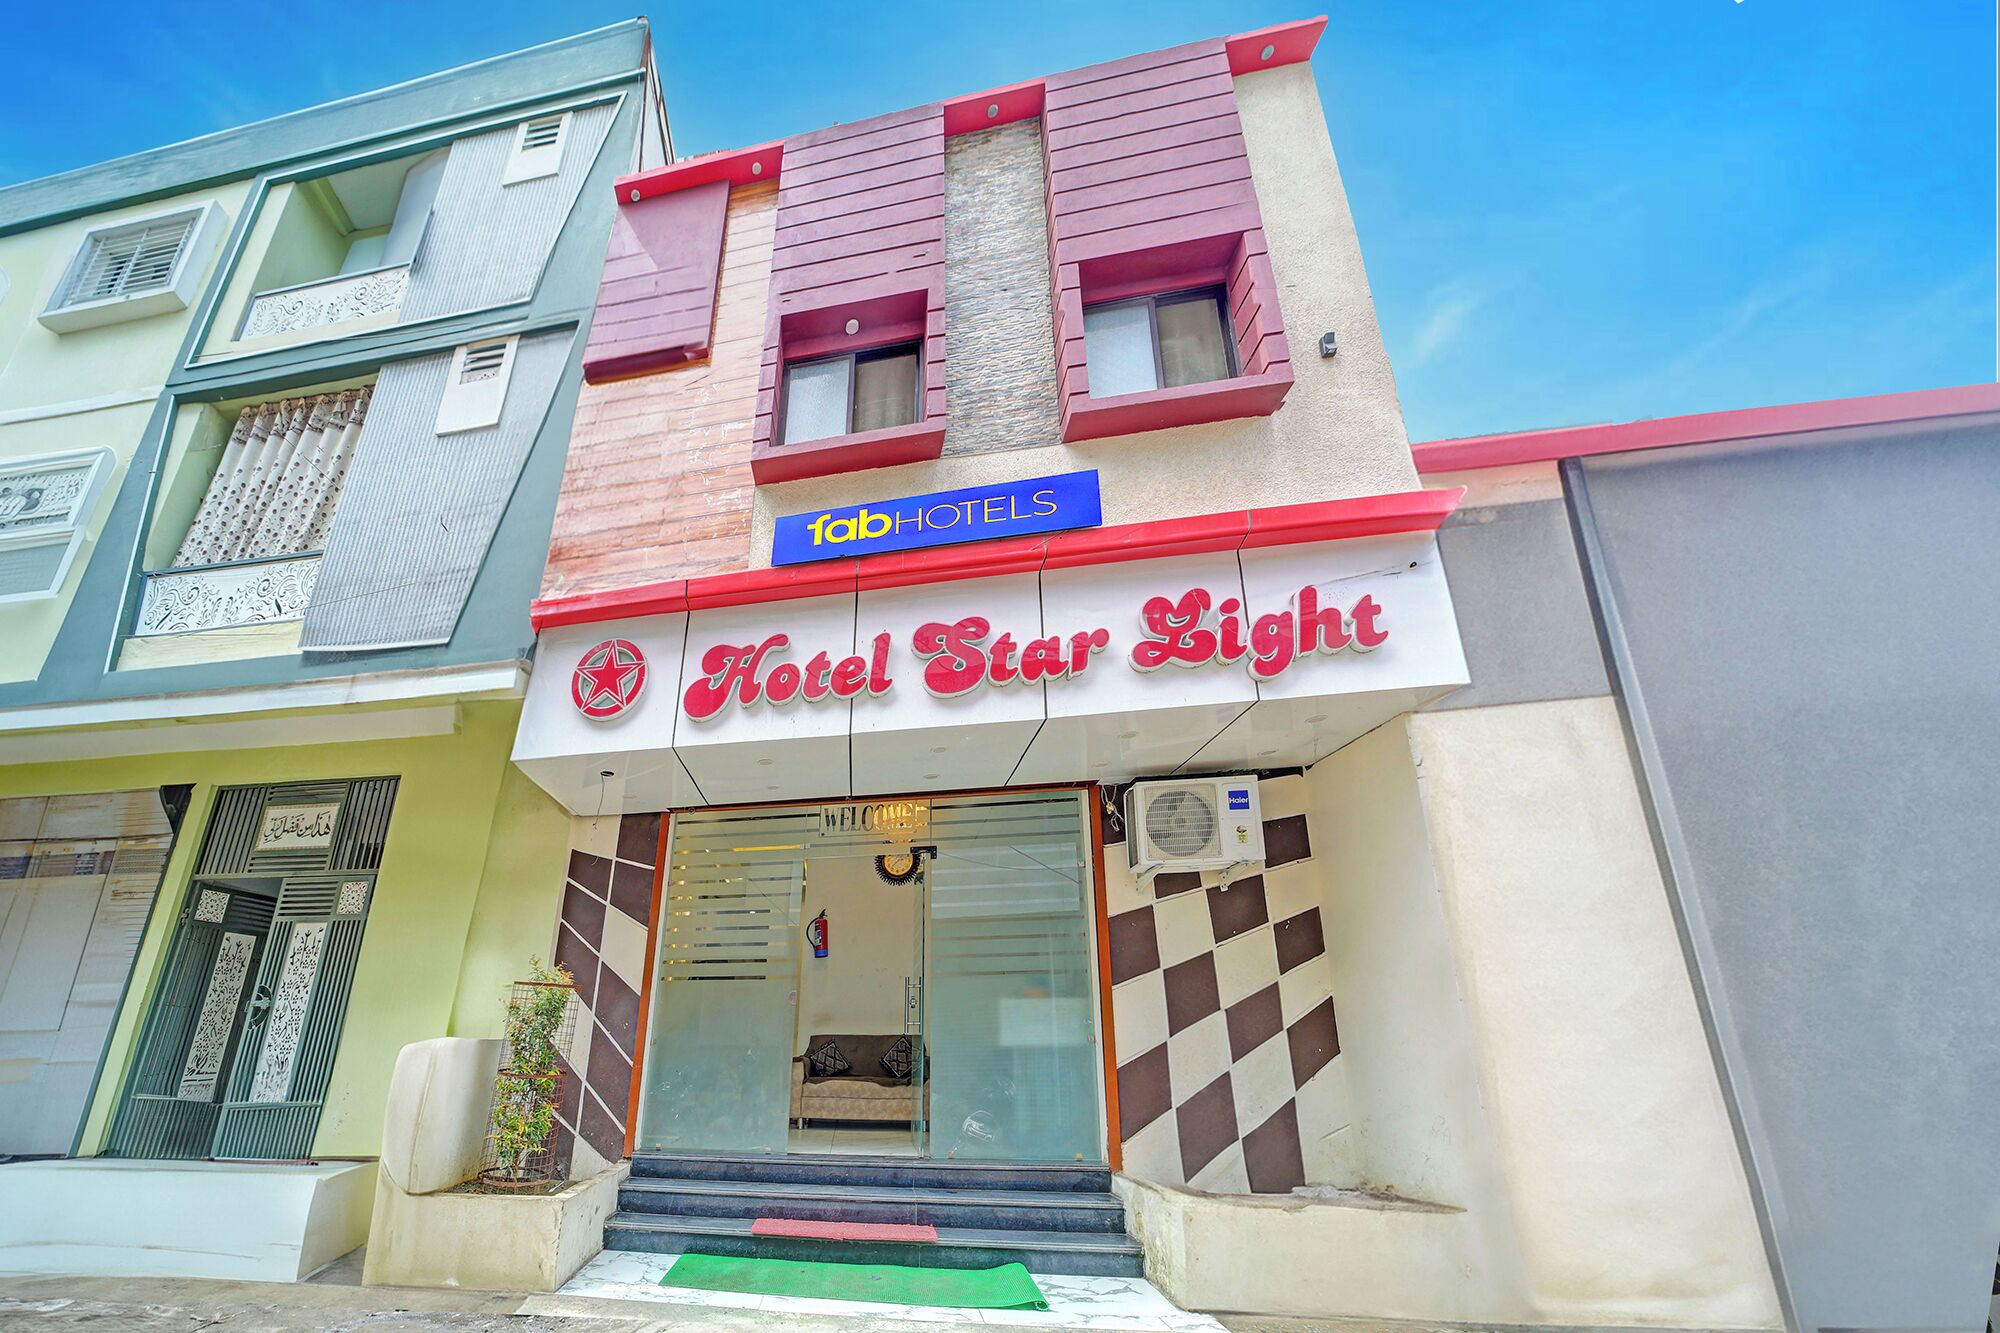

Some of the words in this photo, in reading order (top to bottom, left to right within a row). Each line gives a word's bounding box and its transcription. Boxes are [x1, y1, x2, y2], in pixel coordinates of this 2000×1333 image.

[683, 632, 893, 723] Hotel
[911, 616, 1110, 699] Star
[1128, 584, 1389, 682] Light
[1229, 796, 1249, 804] Haier
[824, 802, 914, 832] WELCOME
